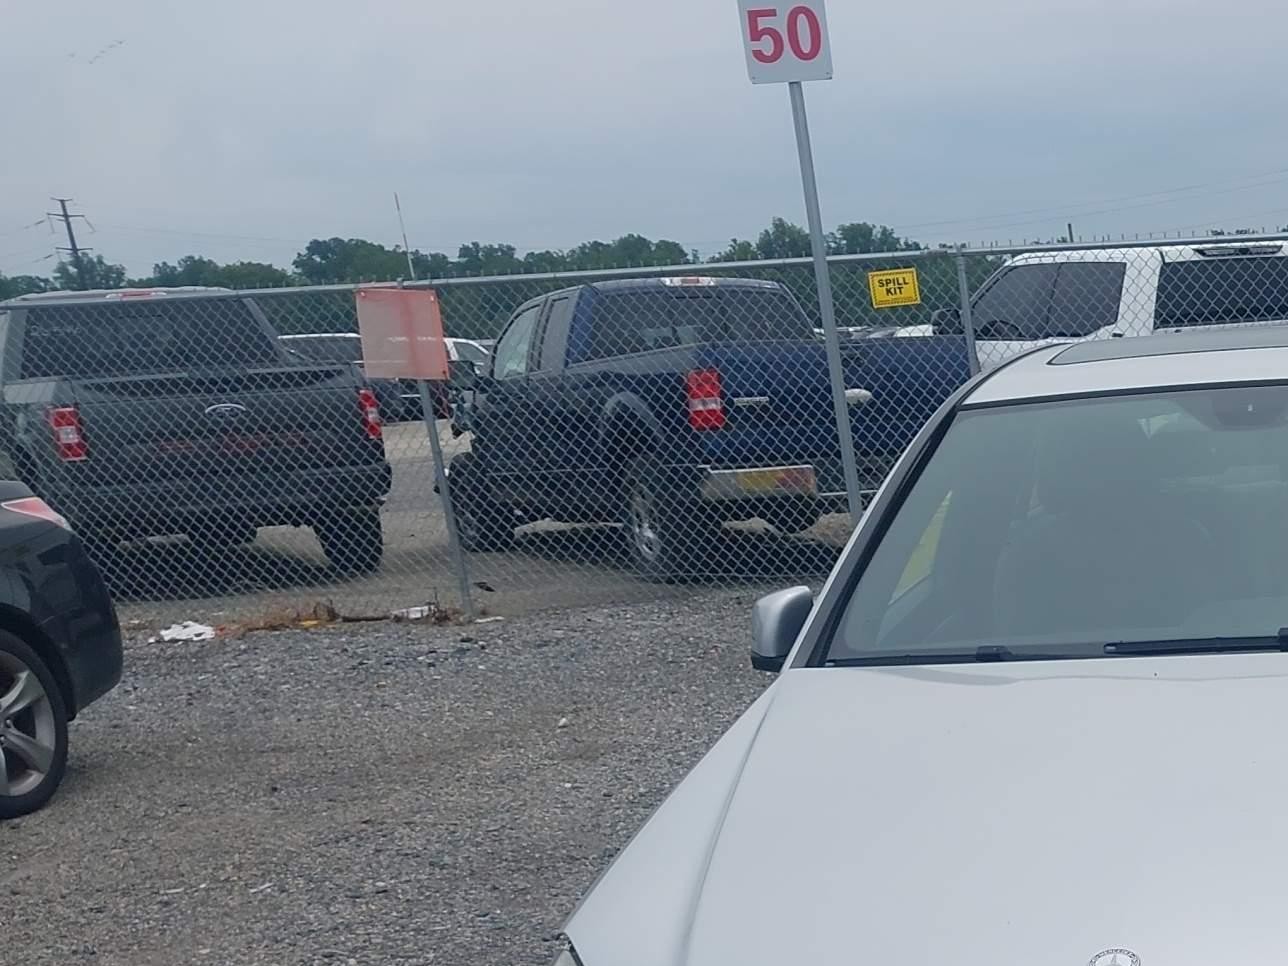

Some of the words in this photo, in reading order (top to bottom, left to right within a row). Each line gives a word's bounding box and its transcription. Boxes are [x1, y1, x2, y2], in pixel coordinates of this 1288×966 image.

[747, 5, 822, 64] 50
[877, 276, 909, 288] SPILL
[885, 286, 904, 297] KIT
